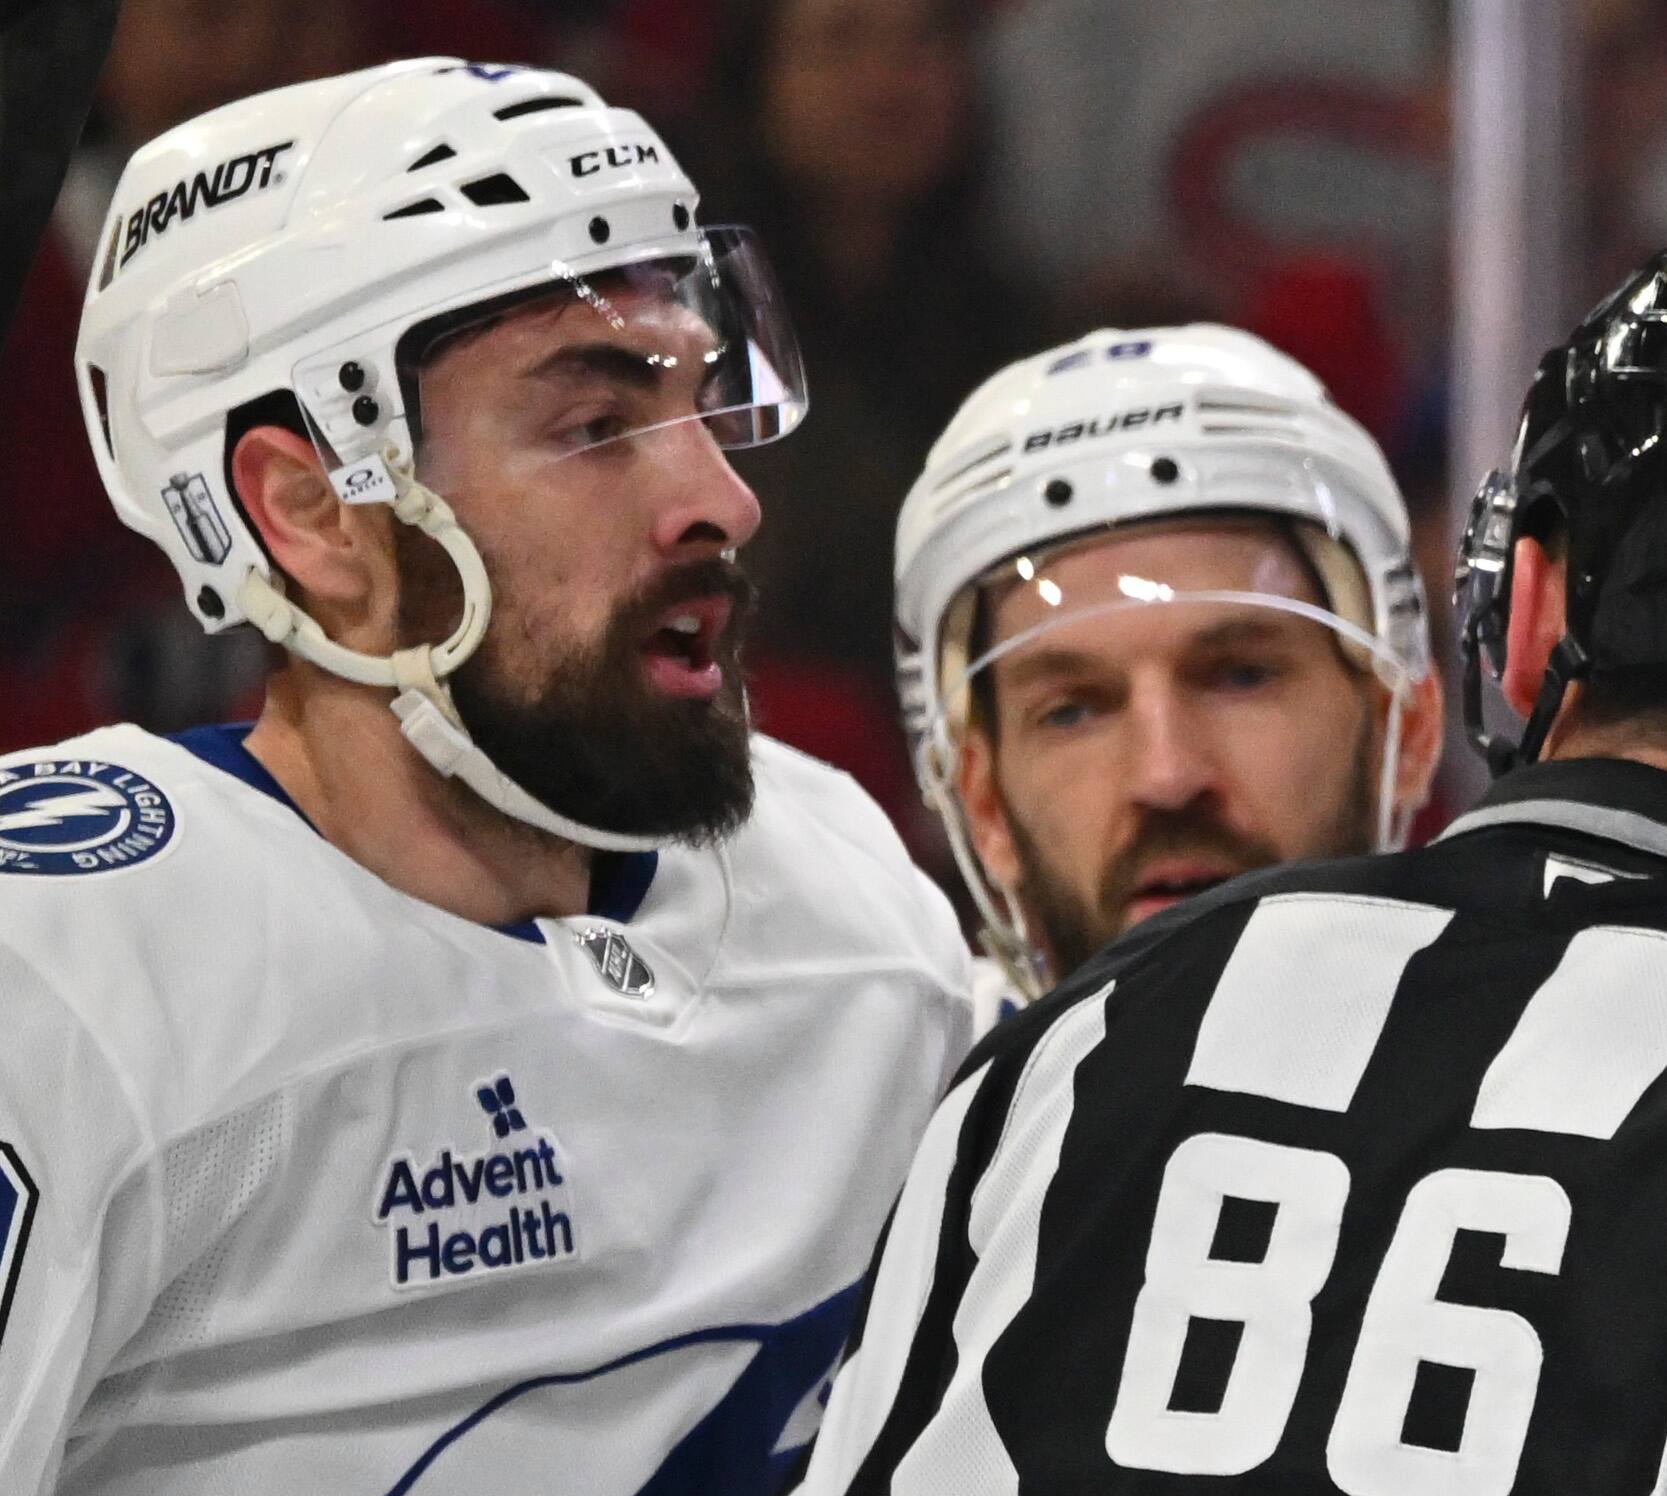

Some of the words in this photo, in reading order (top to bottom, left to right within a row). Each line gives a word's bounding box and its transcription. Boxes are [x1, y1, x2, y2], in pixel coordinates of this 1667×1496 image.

[567, 144, 660, 179] CCM
[120, 140, 293, 269] BRANDT
[1023, 402, 1188, 451] BAUER
[70, 772, 168, 870] LIGHTNING
[378, 1136, 564, 1221] Advent
[395, 1200, 575, 1285] Health
